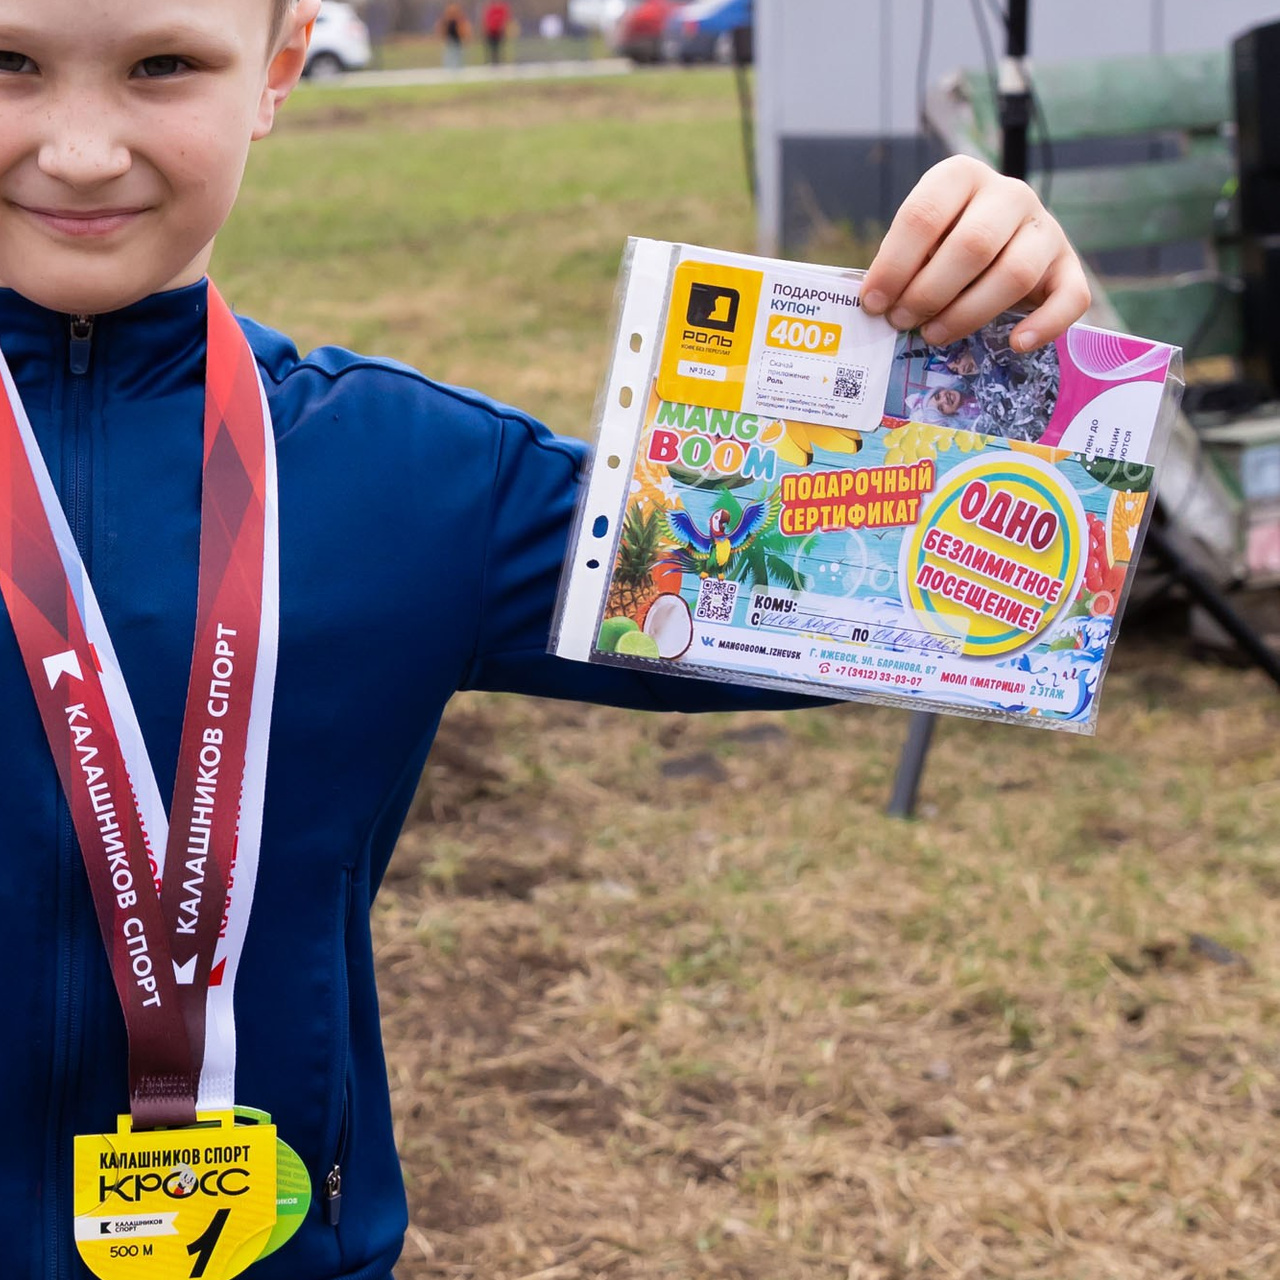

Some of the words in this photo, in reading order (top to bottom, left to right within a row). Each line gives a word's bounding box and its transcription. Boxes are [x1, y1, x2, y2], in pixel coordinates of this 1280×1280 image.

[682, 330, 733, 347] РОЛЬ
[768, 370, 810, 380] приложение
[770, 359, 793, 368] Скачай
[767, 376, 783, 384] Роль
[1090, 419, 1099, 433] до
[649, 429, 776, 479] BOOM
[784, 460, 933, 500] ПОДАРОЧНЫЙ
[784, 499, 919, 532] СЕРТИФИКАТ
[961, 482, 1058, 550] ОДНО
[924, 528, 1063, 602] БЕЗЛИМИТНОЕ
[754, 595, 797, 613] КОМУ:
[916, 566, 1042, 632] ПОСЕЩЕНИЕ!
[751, 613, 760, 626] С
[852, 628, 869, 642] ПО
[809, 648, 818, 658] Г.
[820, 650, 859, 664] ИЖЕВСК,
[861, 656, 875, 666] УЛ.
[925, 665, 937, 675] 87
[835, 666, 846, 675] +7
[848, 667, 878, 681] (3412)
[879, 671, 922, 687] 33-03-07
[940, 672, 967, 686] МОЛЛ
[970, 677, 1026, 694] «МАТРИЦА»
[1029, 686, 1036, 695] 2
[1037, 687, 1065, 700] ЭТАЖ
[176, 728, 224, 935] КАЛАШНИКОВ
[207, 623, 238, 718] СПОРТ
[65, 702, 138, 910] КАЛАШНИКОВ
[123, 916, 162, 1009] СПОРТ
[100, 1149, 200, 1169] КАЛАШНИКОВ
[204, 1145, 251, 1164] СПОРТ
[99, 1168, 251, 1202] КРОСС
[115, 1219, 163, 1228] КАЛАШНИКОВ
[110, 1245, 139, 1258] 500
[186, 1208, 231, 1278] 1
